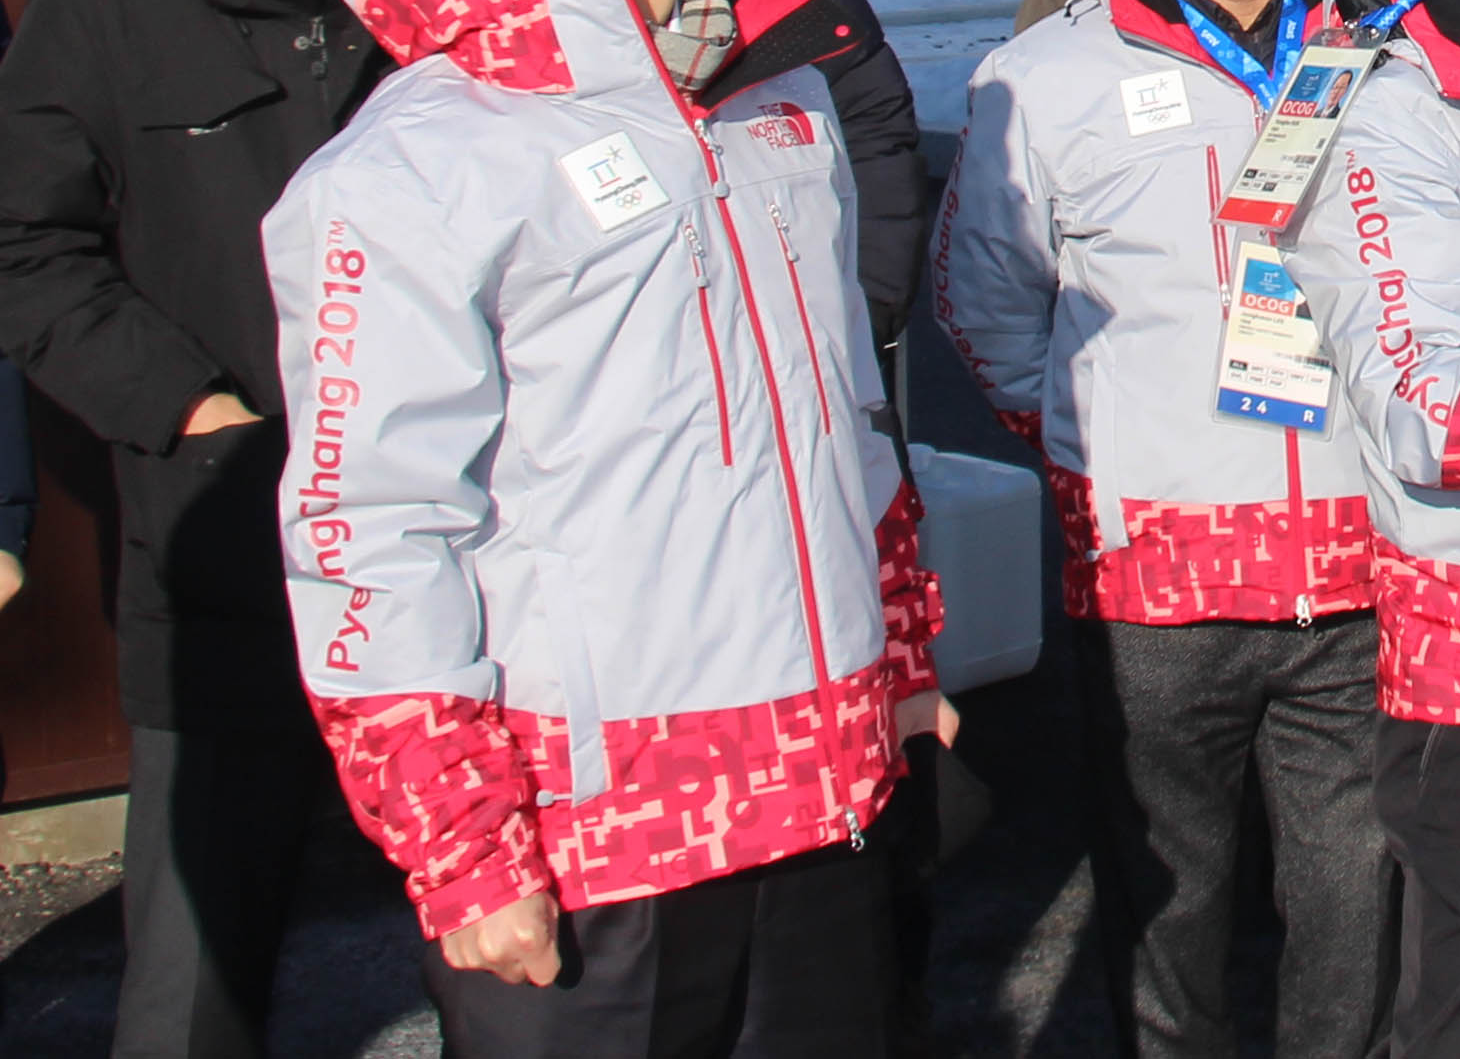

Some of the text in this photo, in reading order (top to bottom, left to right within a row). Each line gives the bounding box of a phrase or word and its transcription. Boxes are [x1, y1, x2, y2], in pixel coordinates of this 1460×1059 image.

[1282, 100, 1315, 116] OCOG
[1244, 293, 1291, 313] OCOG
[1303, 409, 1315, 423] R
